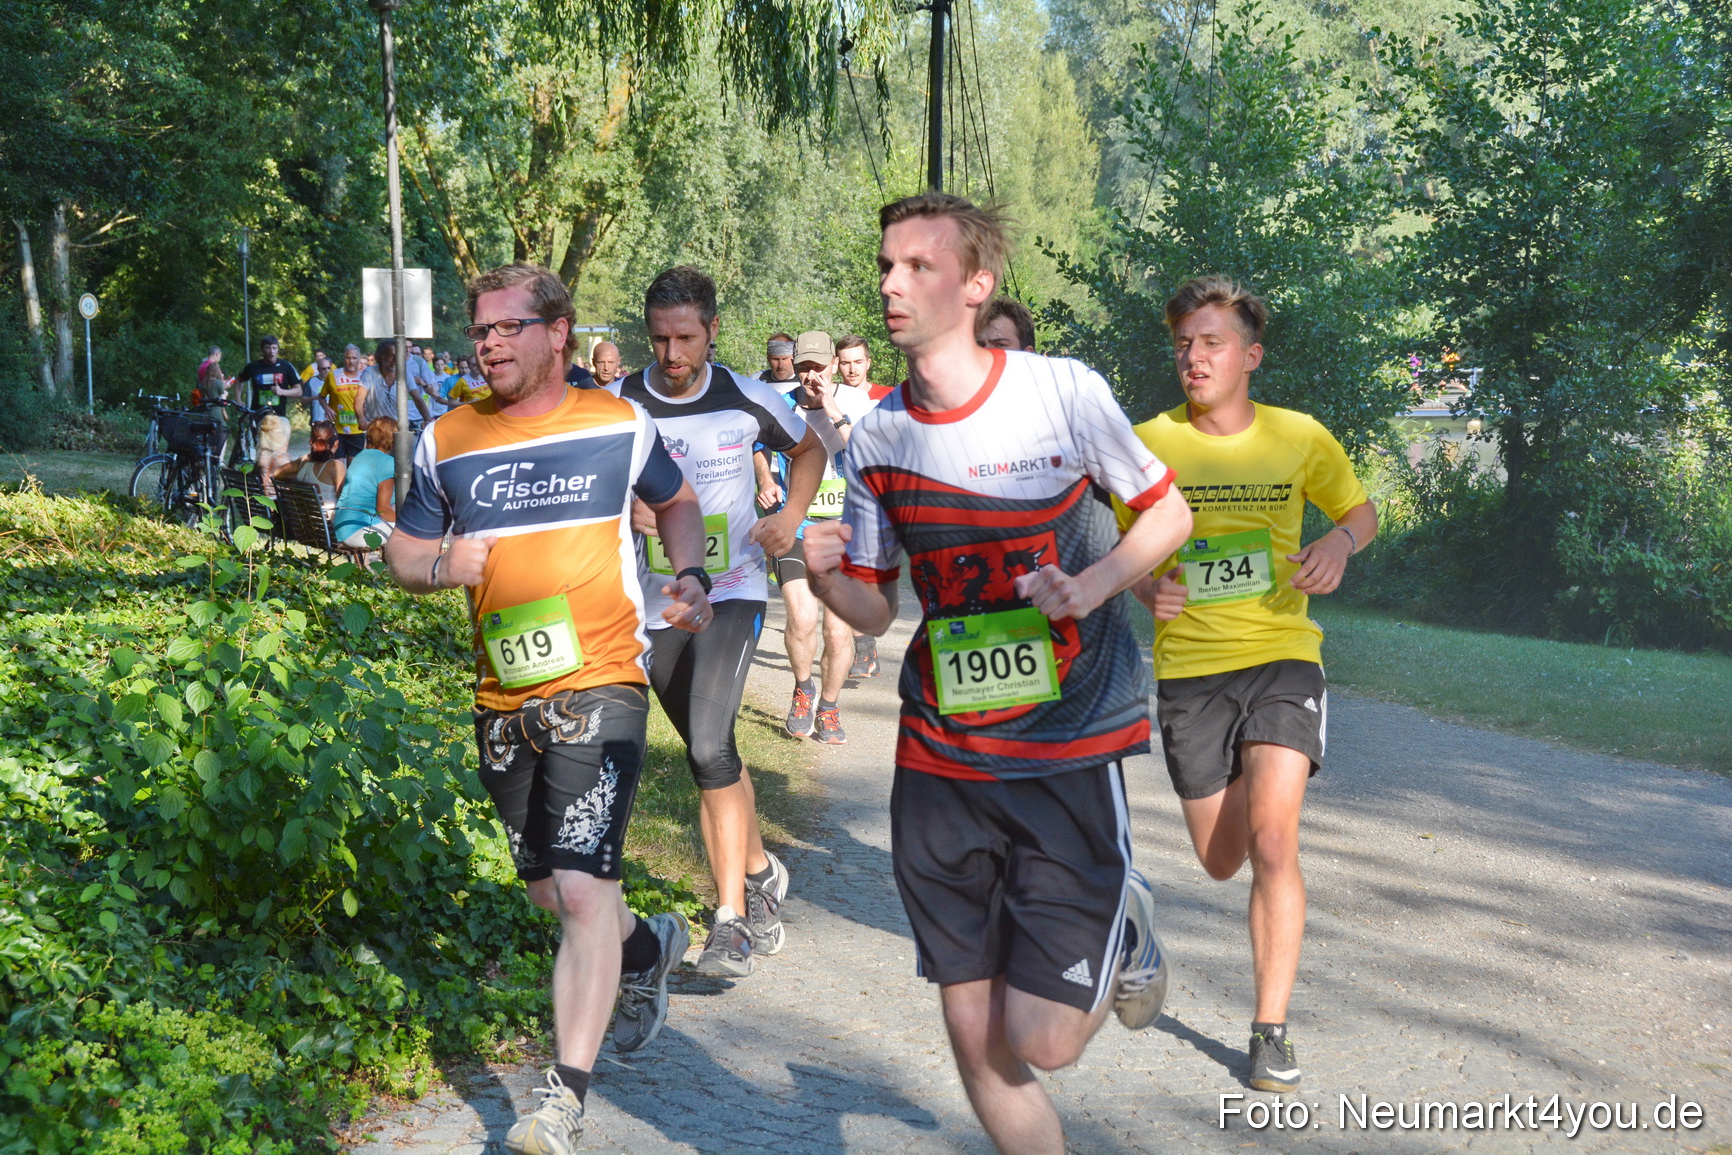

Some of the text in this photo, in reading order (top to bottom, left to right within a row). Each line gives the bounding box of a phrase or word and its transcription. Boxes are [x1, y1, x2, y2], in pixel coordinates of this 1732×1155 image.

[696, 453, 744, 469] VORSICHT!
[968, 457, 1047, 478] NEUMARKT
[492, 473, 597, 500] Fischer
[502, 492, 589, 511] AUTOMOBILE
[1269, 503, 1288, 511] BÜRO
[1199, 556, 1254, 585] 734
[1222, 580, 1261, 590] Maximilian
[500, 630, 552, 665] 619
[532, 656, 565, 669] Andreas
[948, 643, 1037, 685] 1906
[952, 679, 1040, 697] Neumayer Christian
